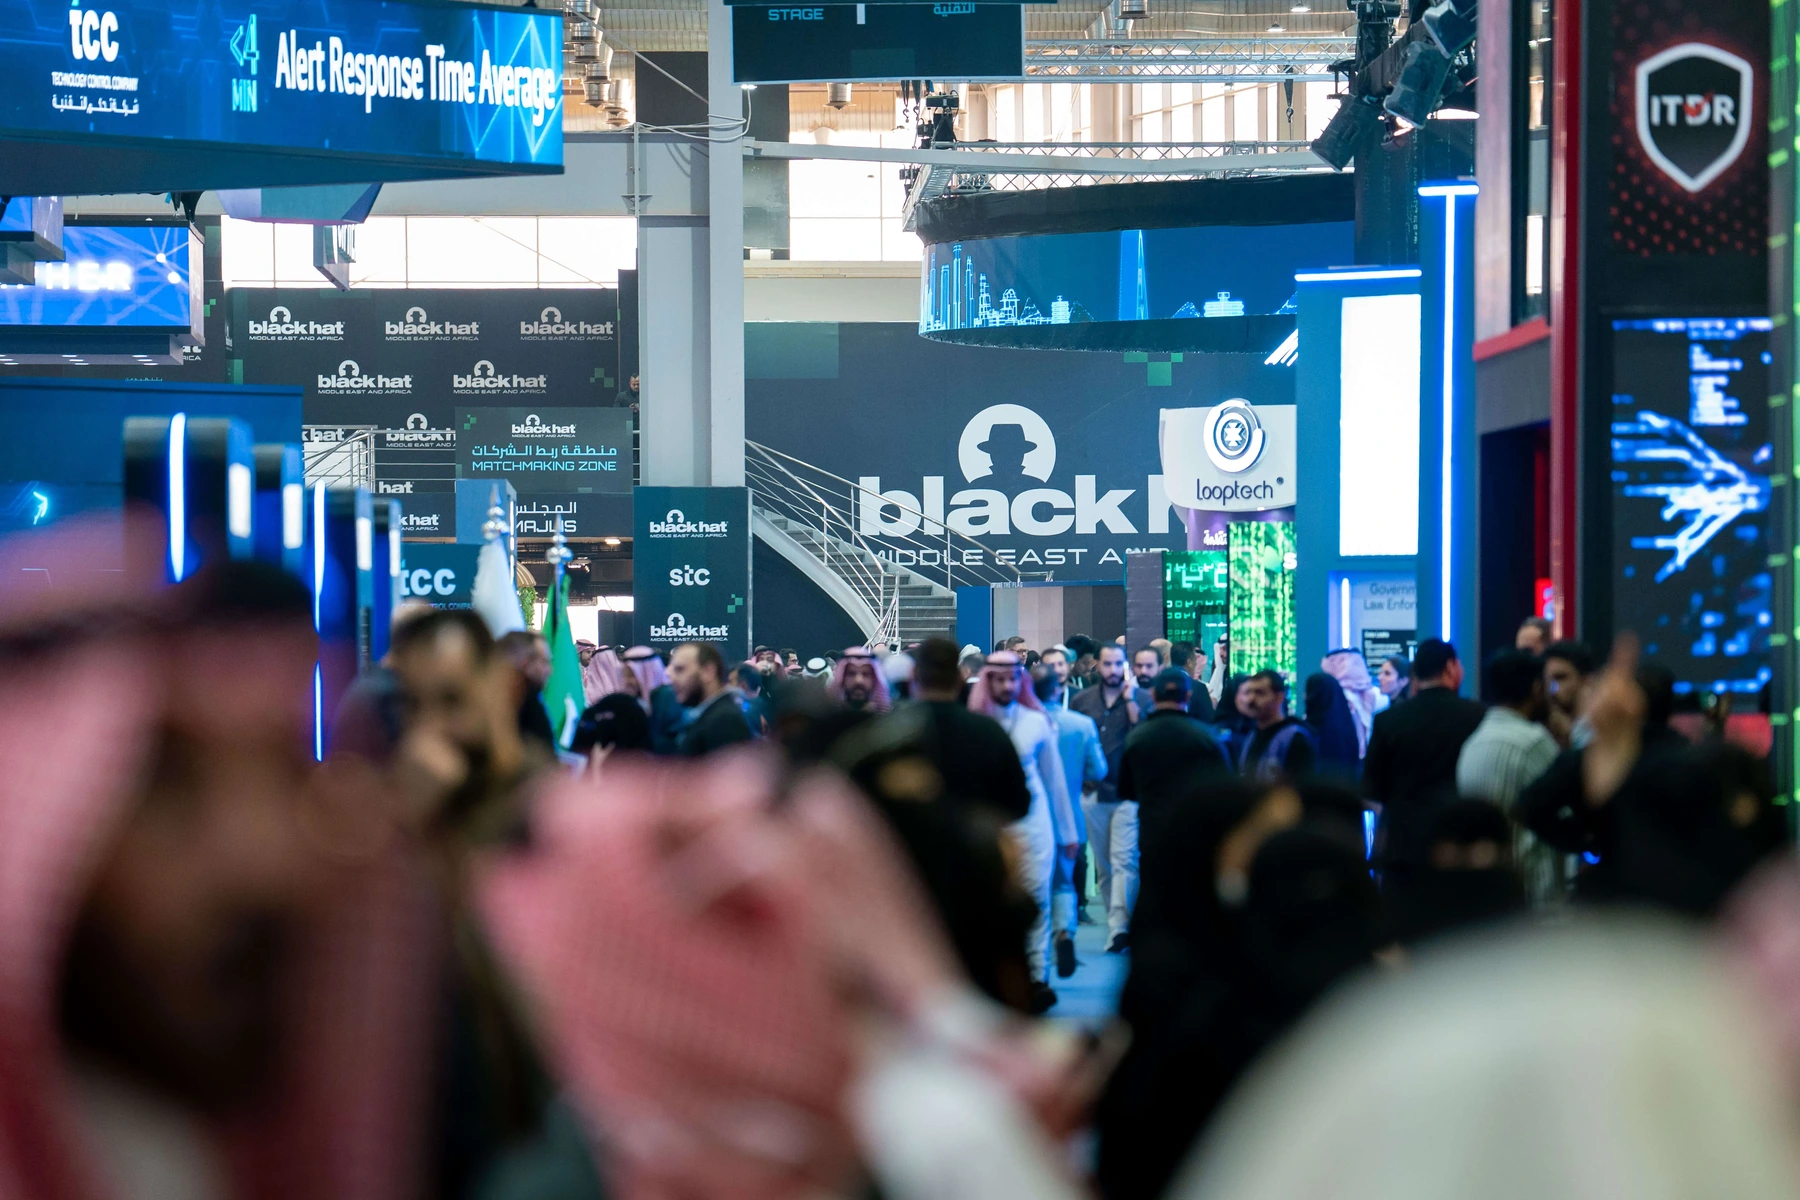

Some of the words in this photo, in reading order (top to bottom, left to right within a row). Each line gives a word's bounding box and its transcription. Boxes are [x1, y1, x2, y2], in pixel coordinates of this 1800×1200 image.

[768, 8, 824, 20] STAGE
[51, 71, 88, 88] TECHNOLOGY
[87, 74, 113, 90] CONTROL
[112, 76, 139, 91] COMPANY
[275, 29, 326, 92] Alert
[329, 36, 424, 114] Response
[425, 43, 475, 104] Time
[478, 49, 556, 127] Average
[232, 78, 258, 113] MIN
[1650, 94, 1736, 127] ITDR
[249, 320, 308, 335] black
[309, 320, 344, 335] hat
[385, 321, 443, 335] black
[445, 321, 480, 335] hat
[520, 321, 578, 335] black
[580, 321, 613, 335] hat
[317, 374, 376, 388] black
[378, 374, 412, 388] hat
[453, 374, 511, 388] black
[512, 374, 547, 388] hat
[511, 424, 551, 434] black
[552, 424, 576, 434] hat
[472, 443, 533, 458] الشركات
[536, 444, 558, 458] ربط
[561, 444, 617, 456] منطقة
[472, 461, 575, 471] MATCHMAKING
[578, 461, 617, 471] ZONE
[379, 481, 413, 493] hat
[859, 474, 1139, 537] black
[409, 514, 440, 526] hat
[650, 521, 698, 533] black
[699, 521, 728, 533] hat
[995, 548, 1088, 565] EAST
[669, 565, 711, 586] stc
[650, 625, 699, 636] black
[699, 625, 728, 636] hat
